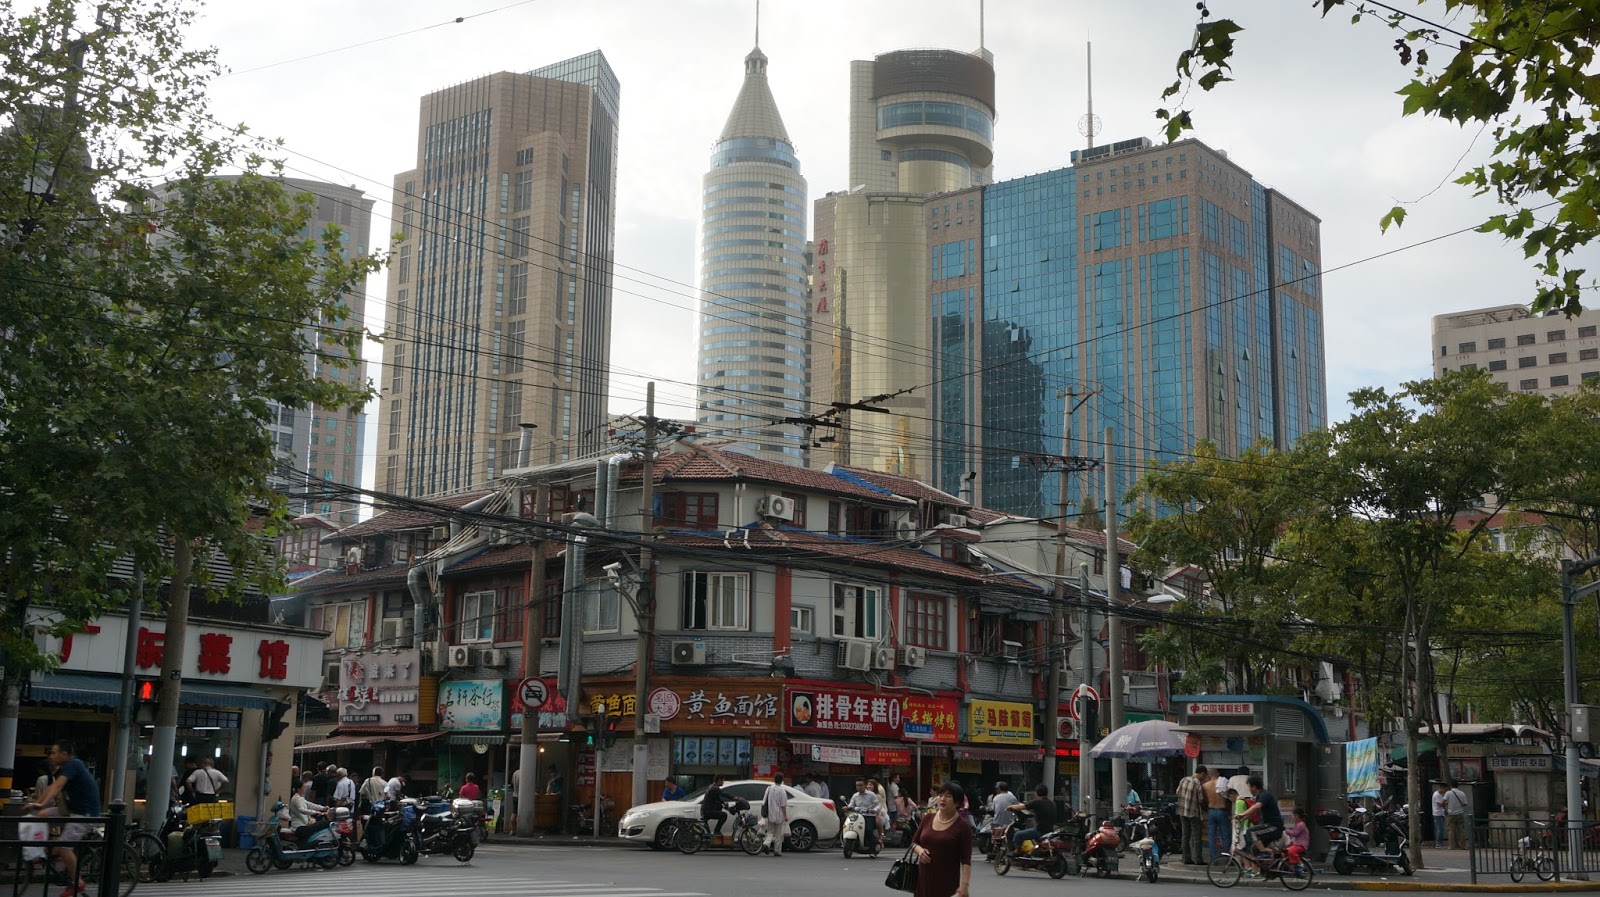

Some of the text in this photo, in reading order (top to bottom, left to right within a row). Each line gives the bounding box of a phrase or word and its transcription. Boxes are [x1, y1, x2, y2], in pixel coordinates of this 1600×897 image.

[682, 689, 778, 720] 黄鱼面馆
[816, 693, 888, 723] 排骨年糕
[1201, 704, 1250, 713] 中国福利彩票
